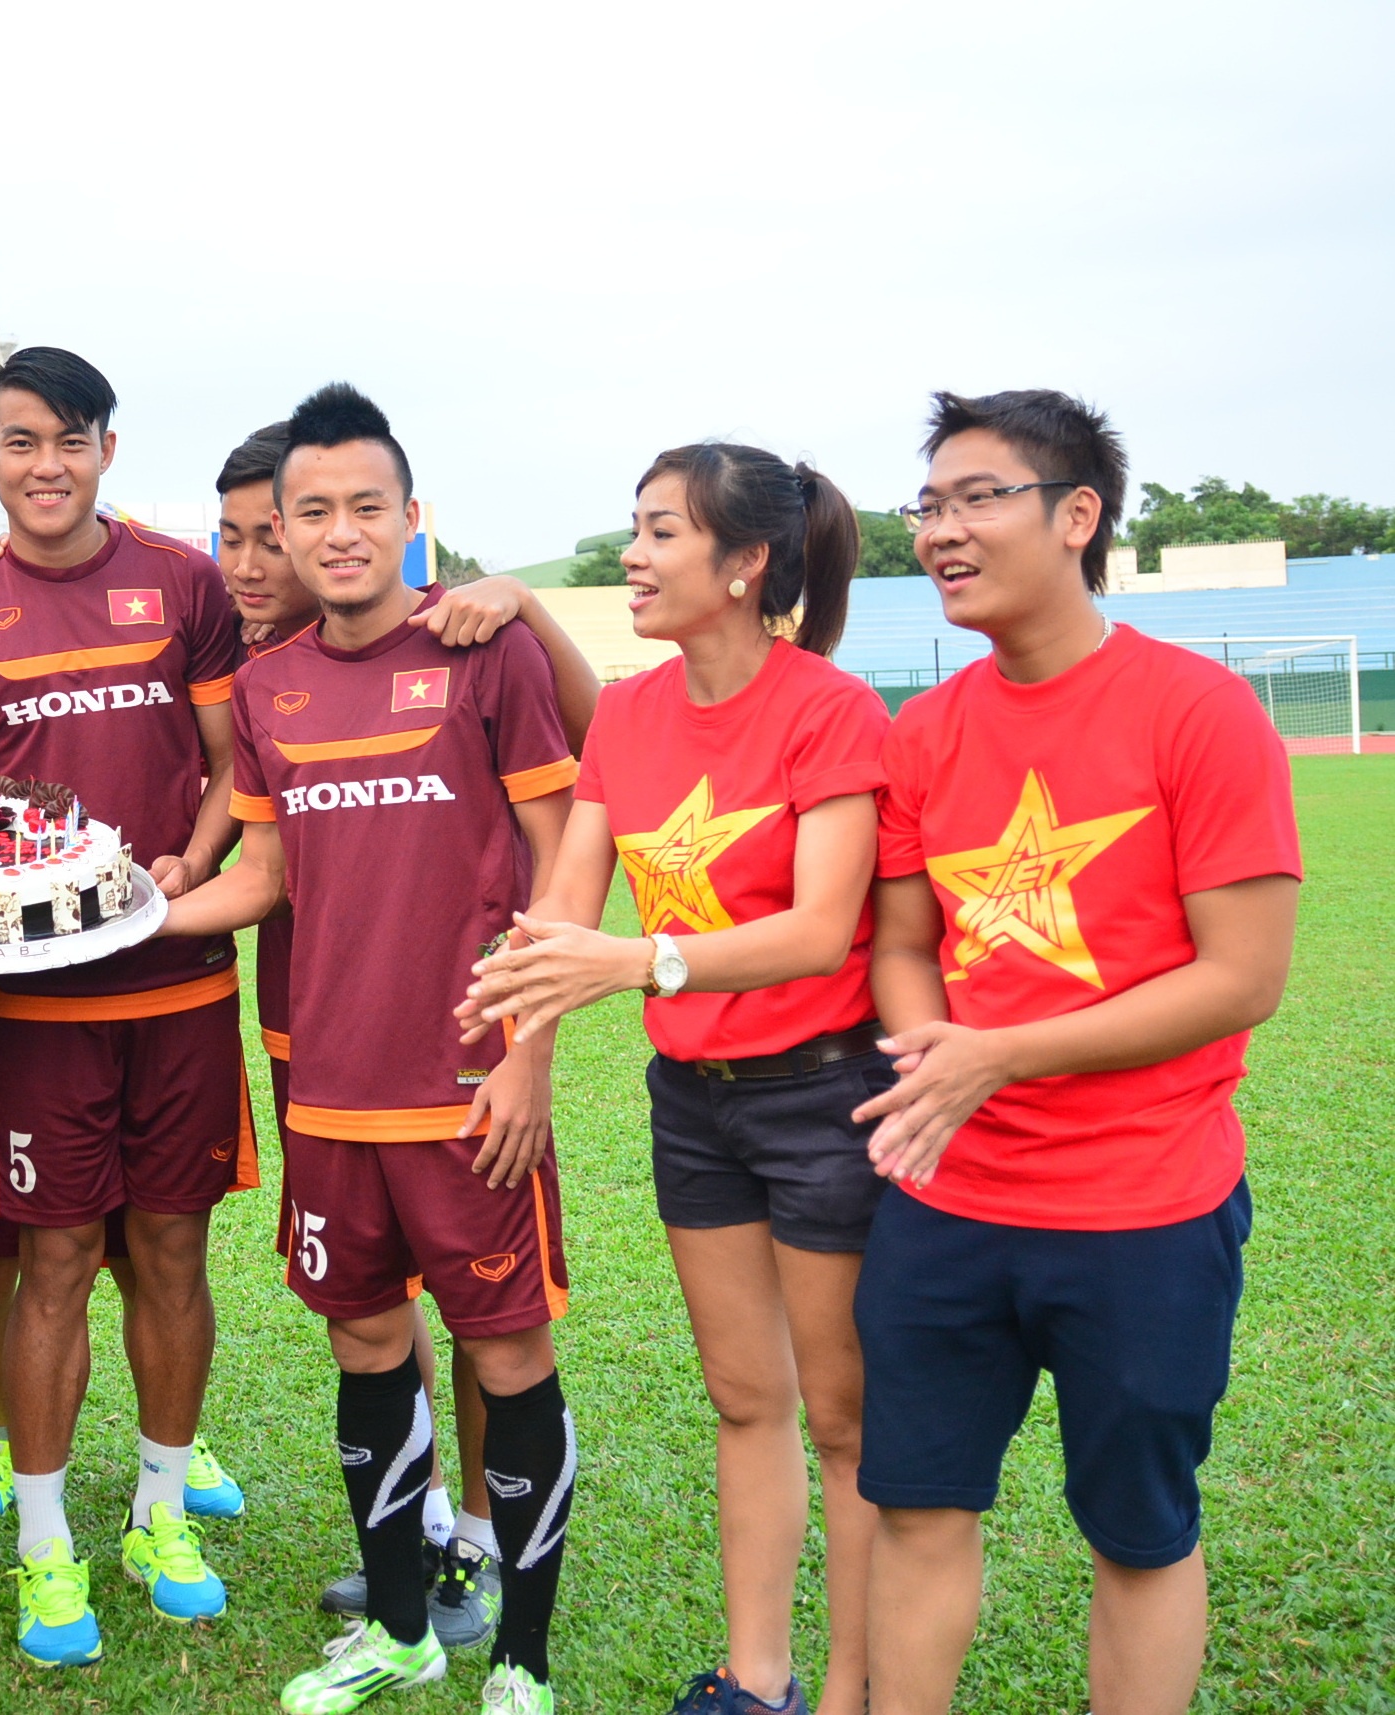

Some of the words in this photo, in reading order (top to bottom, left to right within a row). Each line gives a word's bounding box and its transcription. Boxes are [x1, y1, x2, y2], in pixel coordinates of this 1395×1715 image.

[1, 681, 174, 726] HONDA
[281, 775, 456, 816] HONDA
[9, 1130, 37, 1194] 5
